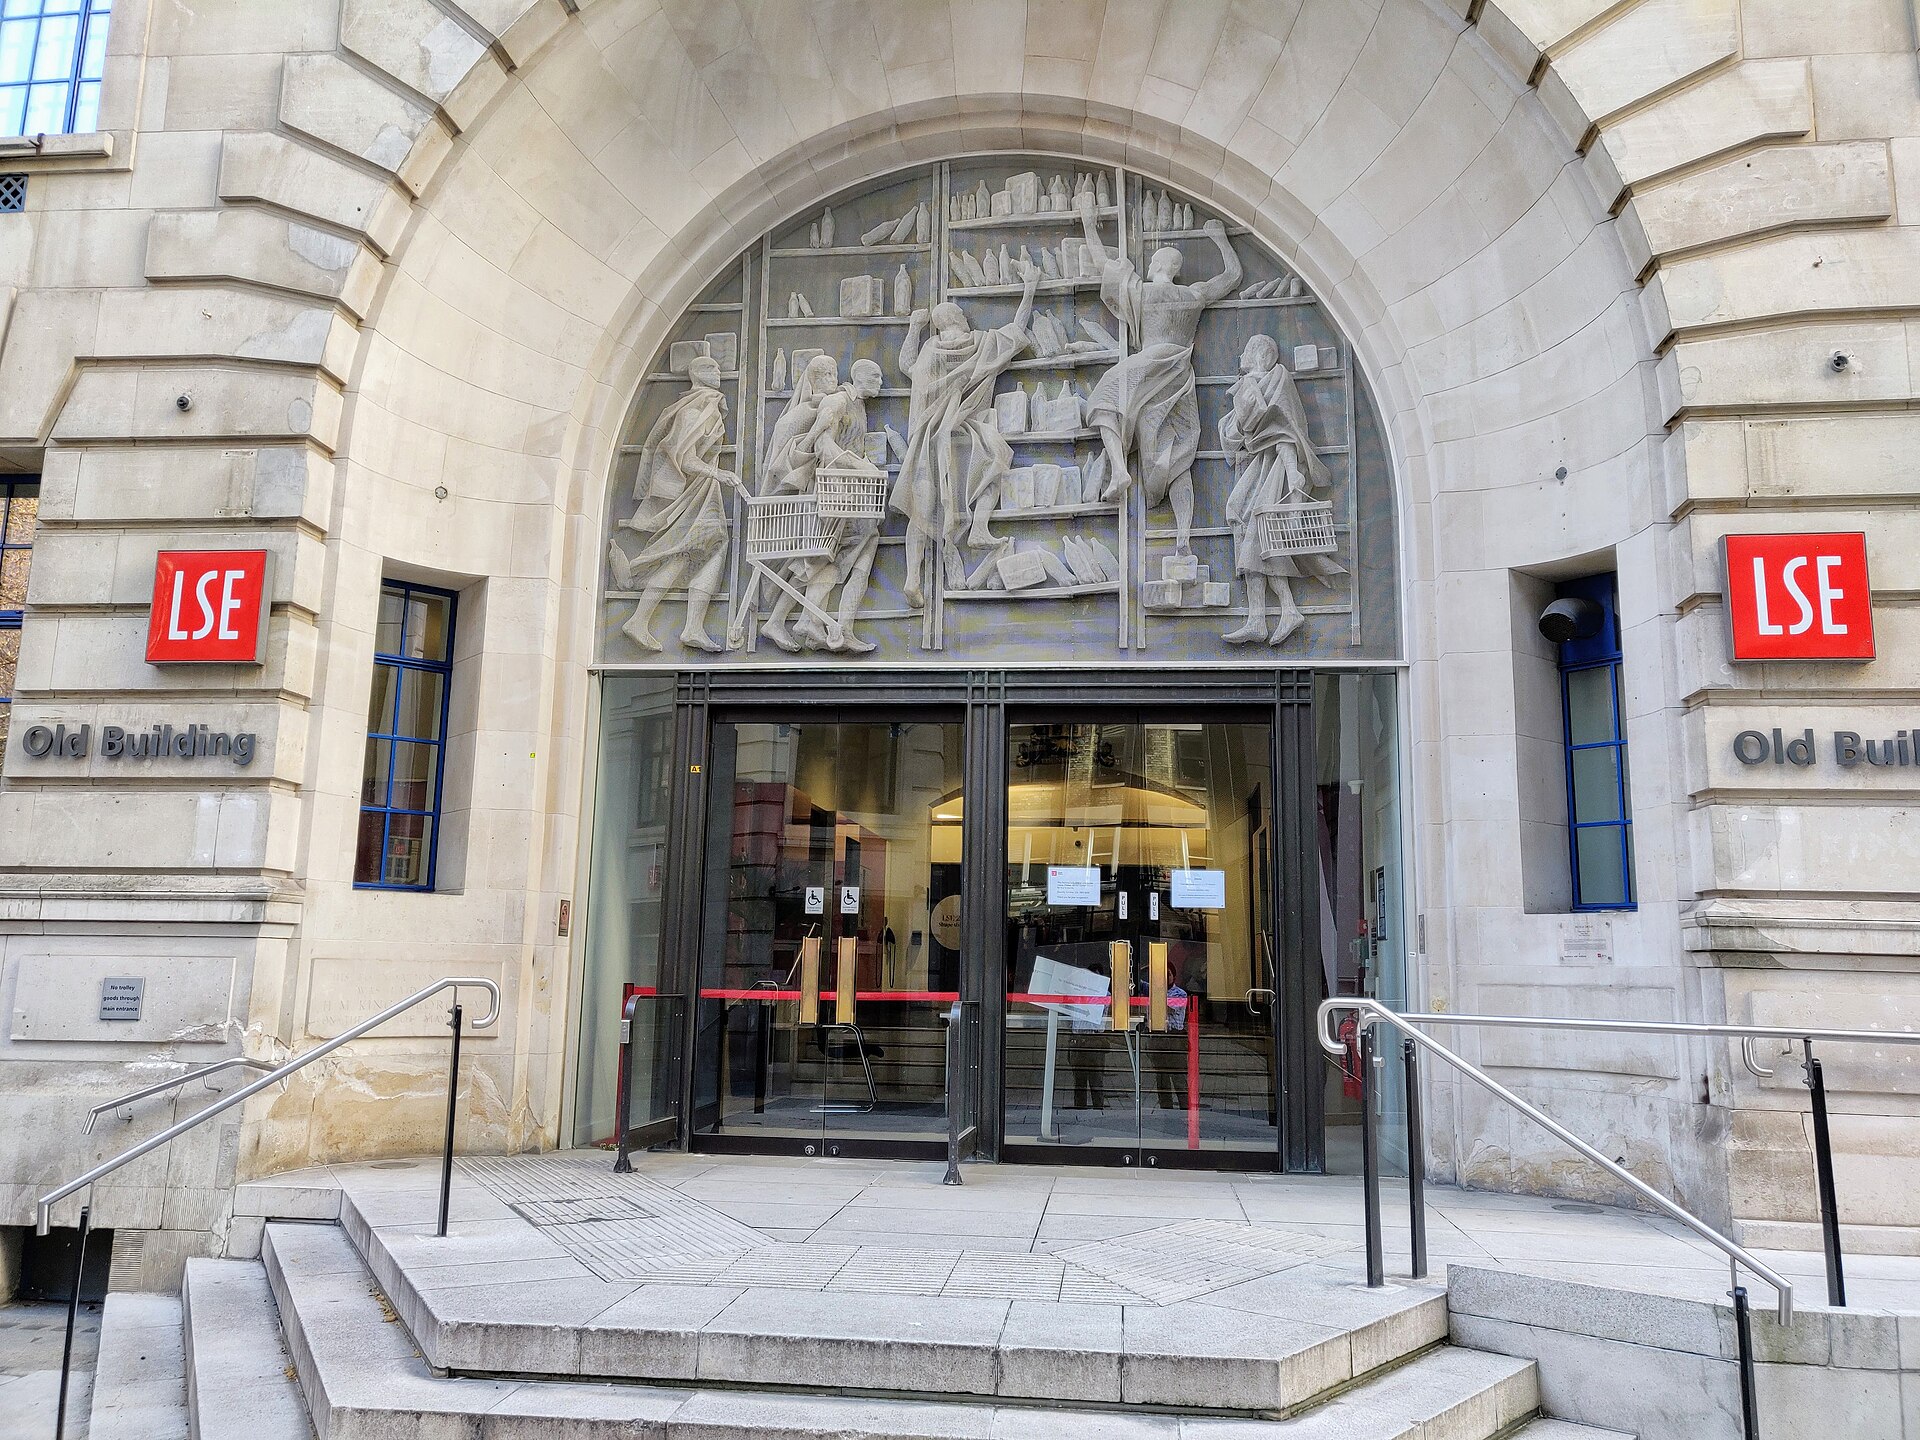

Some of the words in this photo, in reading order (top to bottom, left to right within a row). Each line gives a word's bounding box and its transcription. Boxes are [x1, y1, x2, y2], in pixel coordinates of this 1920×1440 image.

[168, 570, 245, 640] LSE
[1753, 555, 1848, 635] LSE
[22, 724, 90, 758] Old
[100, 723, 257, 765] Building
[1733, 727, 1817, 765] Old
